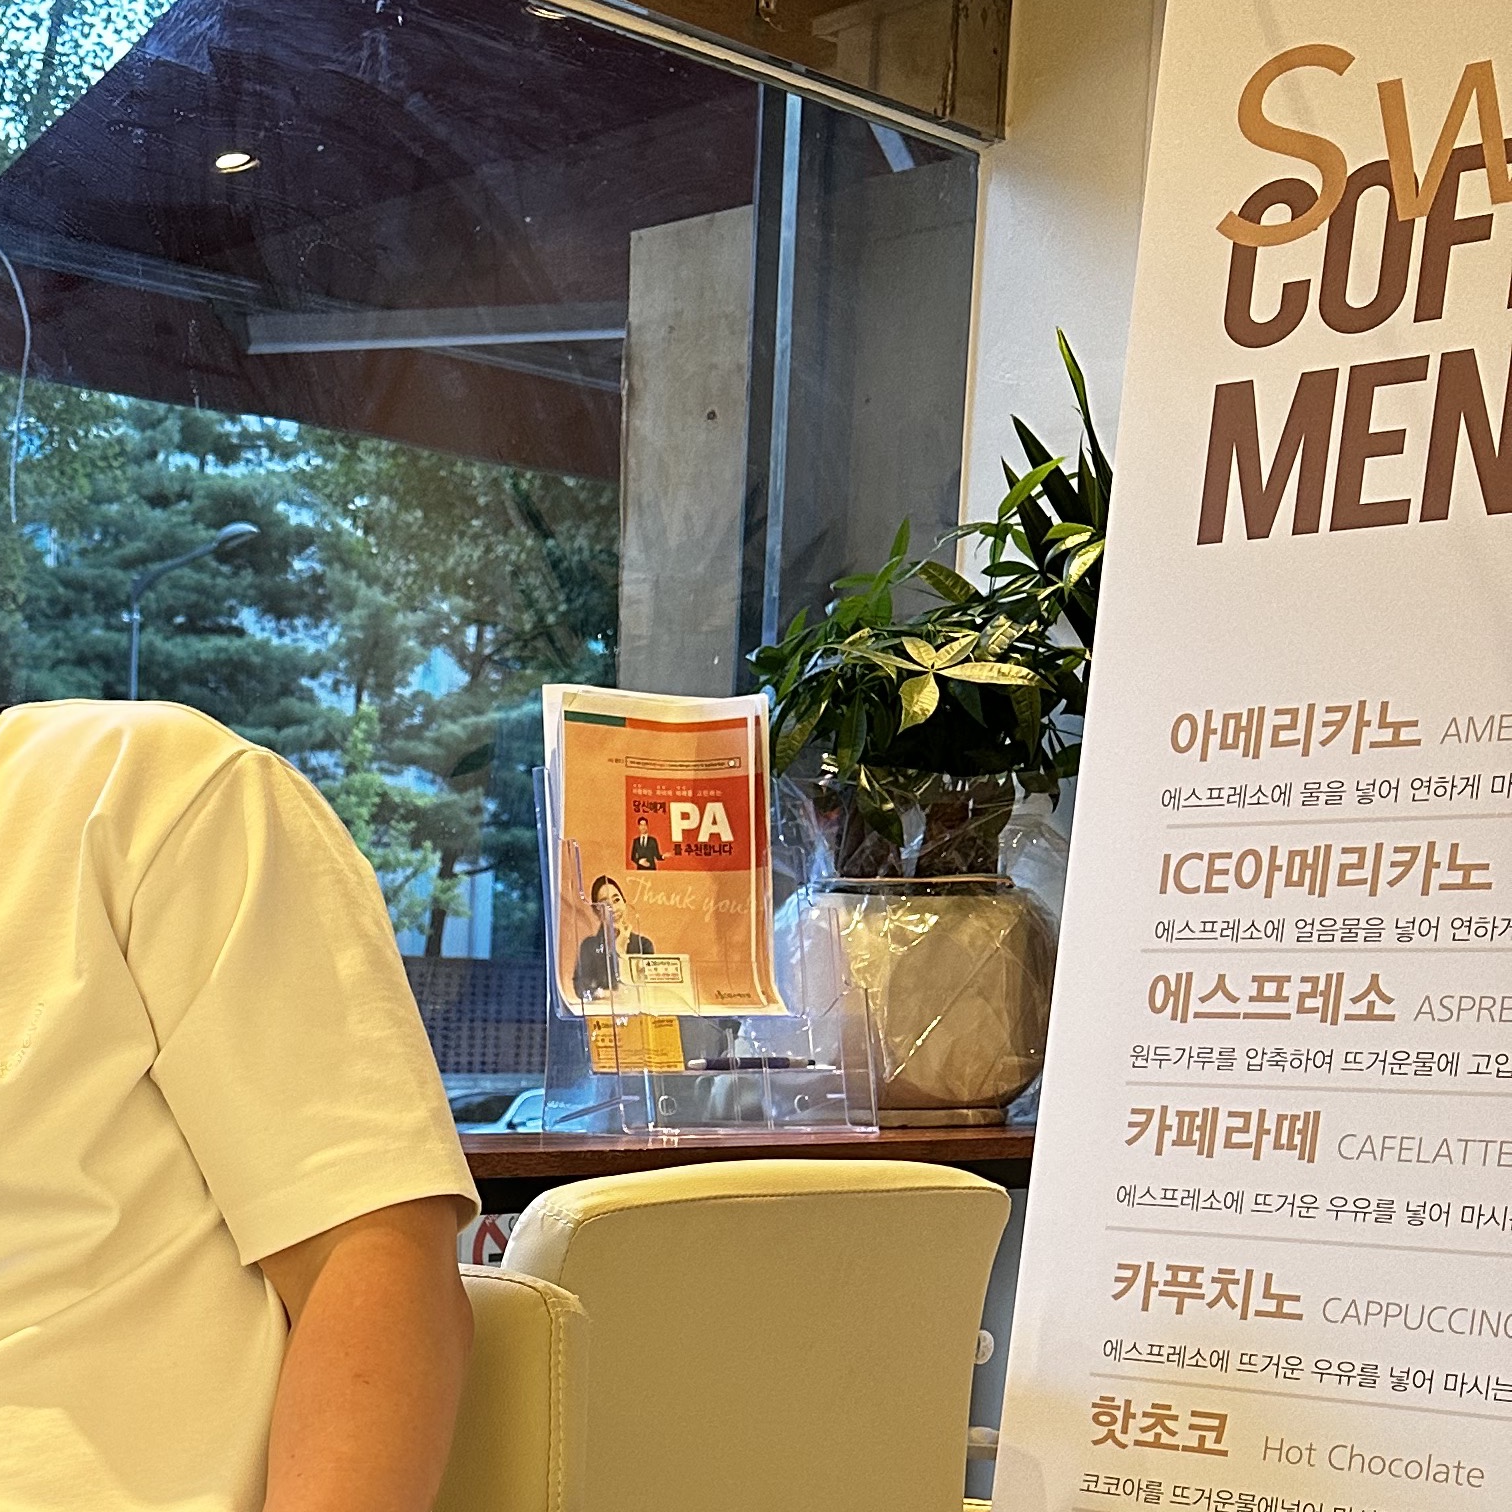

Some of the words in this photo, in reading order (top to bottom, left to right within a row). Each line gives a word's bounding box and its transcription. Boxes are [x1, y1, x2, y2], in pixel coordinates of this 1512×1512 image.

[1224, 137, 1512, 349] COF
[1196, 347, 1512, 546] MEN
[1170, 699, 1422, 762] 아메리카노
[1439, 713, 1512, 745] AME
[1160, 782, 1293, 811] 에스프레소에
[1299, 779, 1347, 806] 물을
[1355, 777, 1400, 806] 넣어
[1409, 773, 1482, 803] 연하게
[669, 801, 735, 843] PA
[626, 876, 696, 910] Thank
[1158, 841, 1493, 899] ICE아메리카노
[1154, 917, 1286, 943] 에스프레소에
[1294, 916, 1386, 944] 얼음물을
[1394, 915, 1440, 943] 넣어
[1148, 971, 1396, 1026] 에스프레소
[1413, 994, 1512, 1024] ASPRE
[1129, 1044, 1238, 1072] 원두가루를
[1245, 1046, 1334, 1075] 압축하여
[1340, 1050, 1460, 1078] 뜨거운물에
[1124, 1105, 1322, 1164] 카페라떼
[1337, 1133, 1512, 1168] CAFELATTE
[1115, 1184, 1245, 1216] 에스프레소에
[1250, 1192, 1320, 1221] 뜨거운
[1325, 1196, 1397, 1226] 우유를
[1405, 1200, 1451, 1229] 넣어
[1460, 1203, 1512, 1233] 마시
[1111, 1260, 1304, 1321] 카푸치노
[1102, 1338, 1230, 1375] 에스프레소에
[1235, 1352, 1305, 1382] 뜨거운
[1310, 1358, 1381, 1390] 우유를
[1389, 1365, 1435, 1396] 넣어
[1443, 1371, 1512, 1403] 마시는
[1090, 1394, 1230, 1458] 핫초코
[1262, 1435, 1316, 1469] Hot
[1328, 1443, 1486, 1489] Chocolate
[1078, 1473, 1165, 1506] 코코아를
